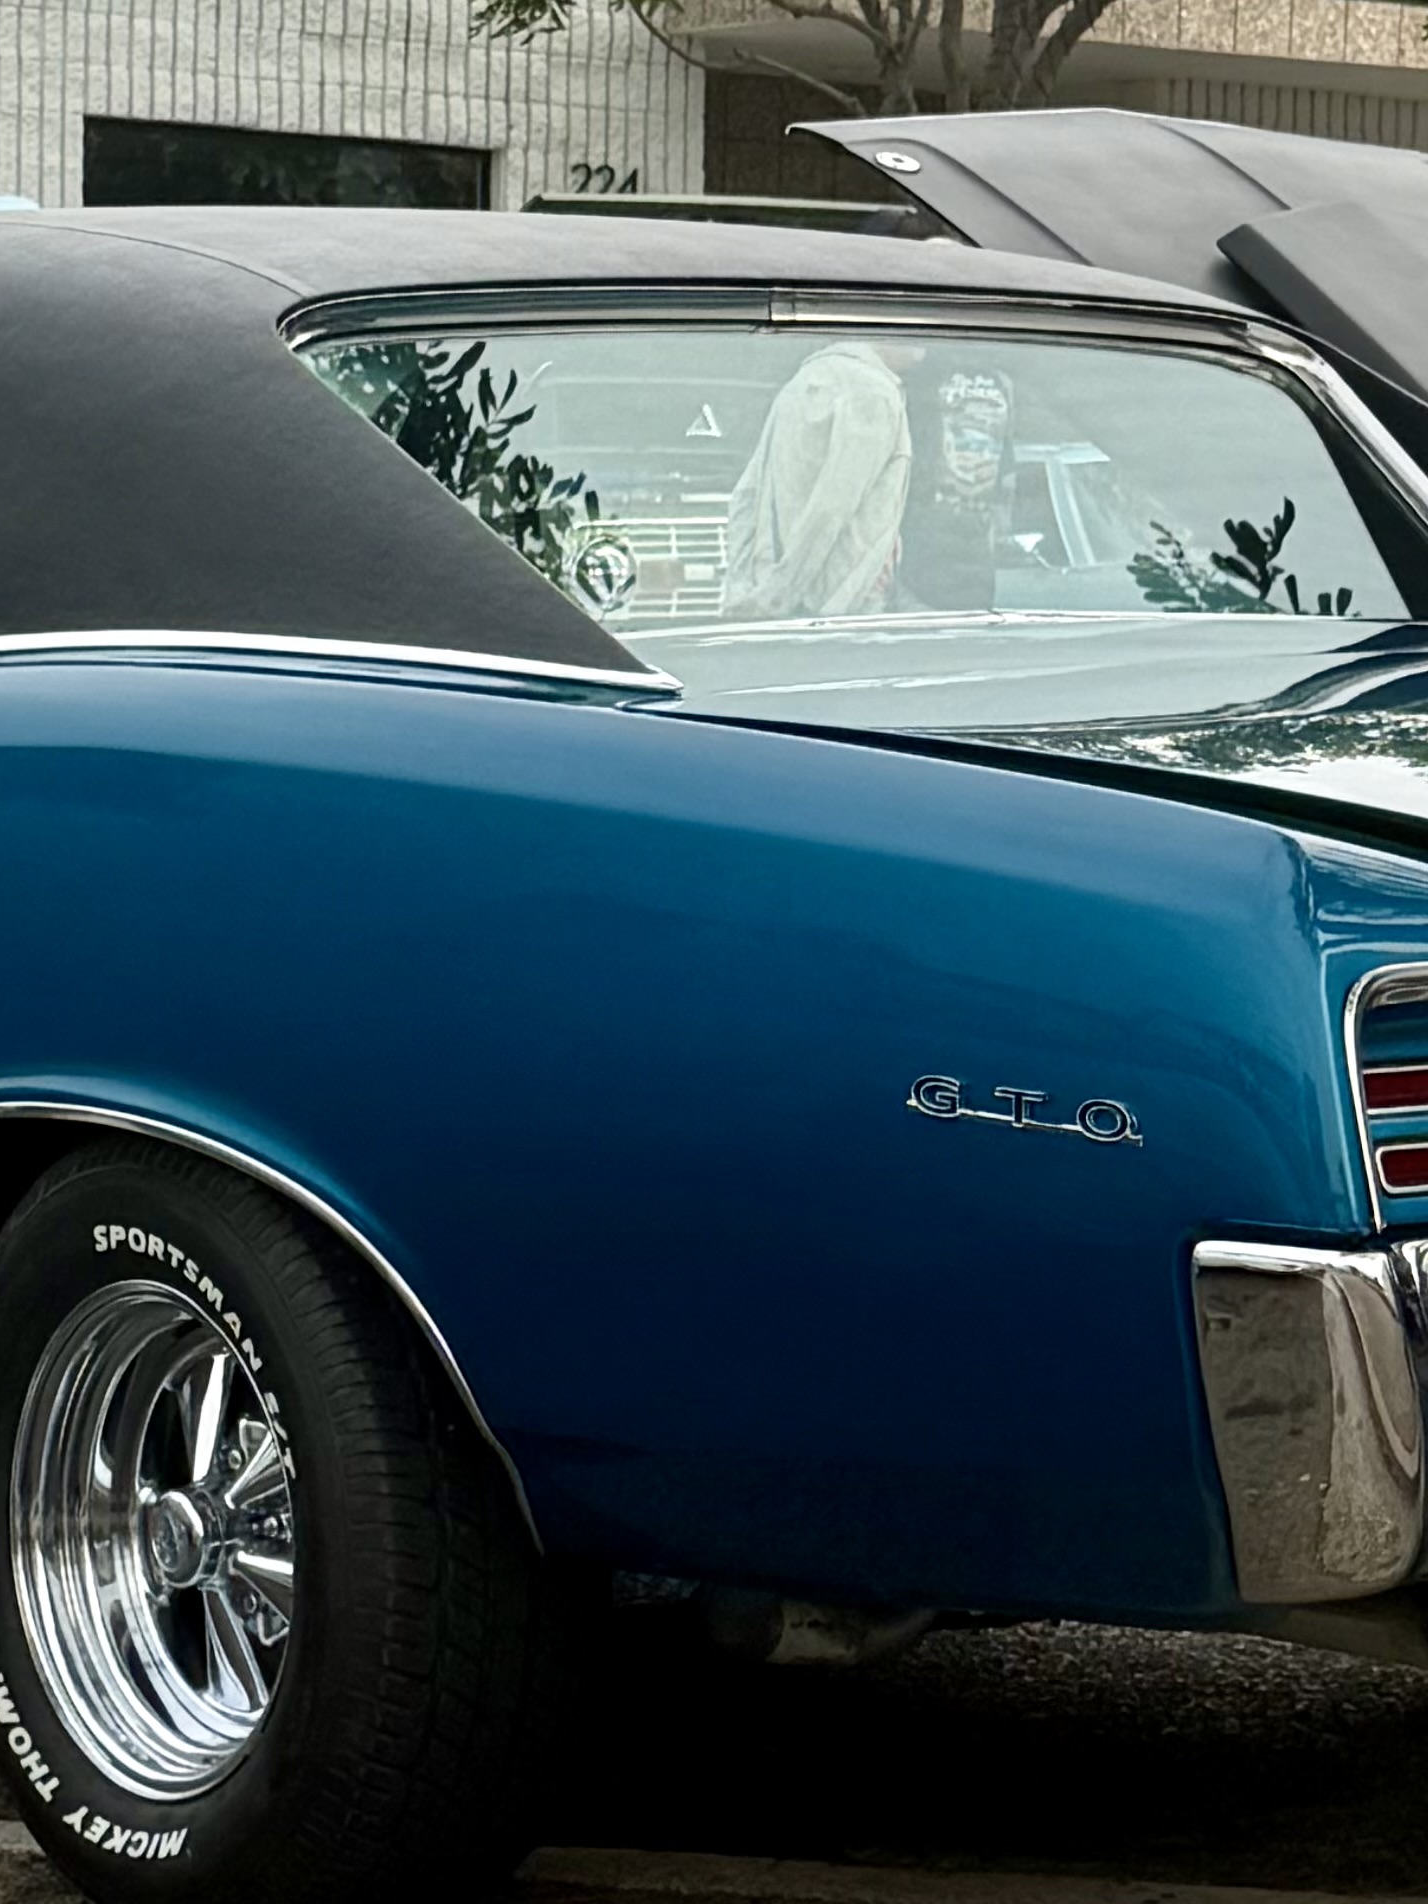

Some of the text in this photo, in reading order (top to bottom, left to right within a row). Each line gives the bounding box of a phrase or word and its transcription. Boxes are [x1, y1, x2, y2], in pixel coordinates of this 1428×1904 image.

[908, 1074, 1138, 1144] GTO
[92, 1224, 263, 1373] SPORTSMAN
[60, 1804, 189, 1860] MICKEY
